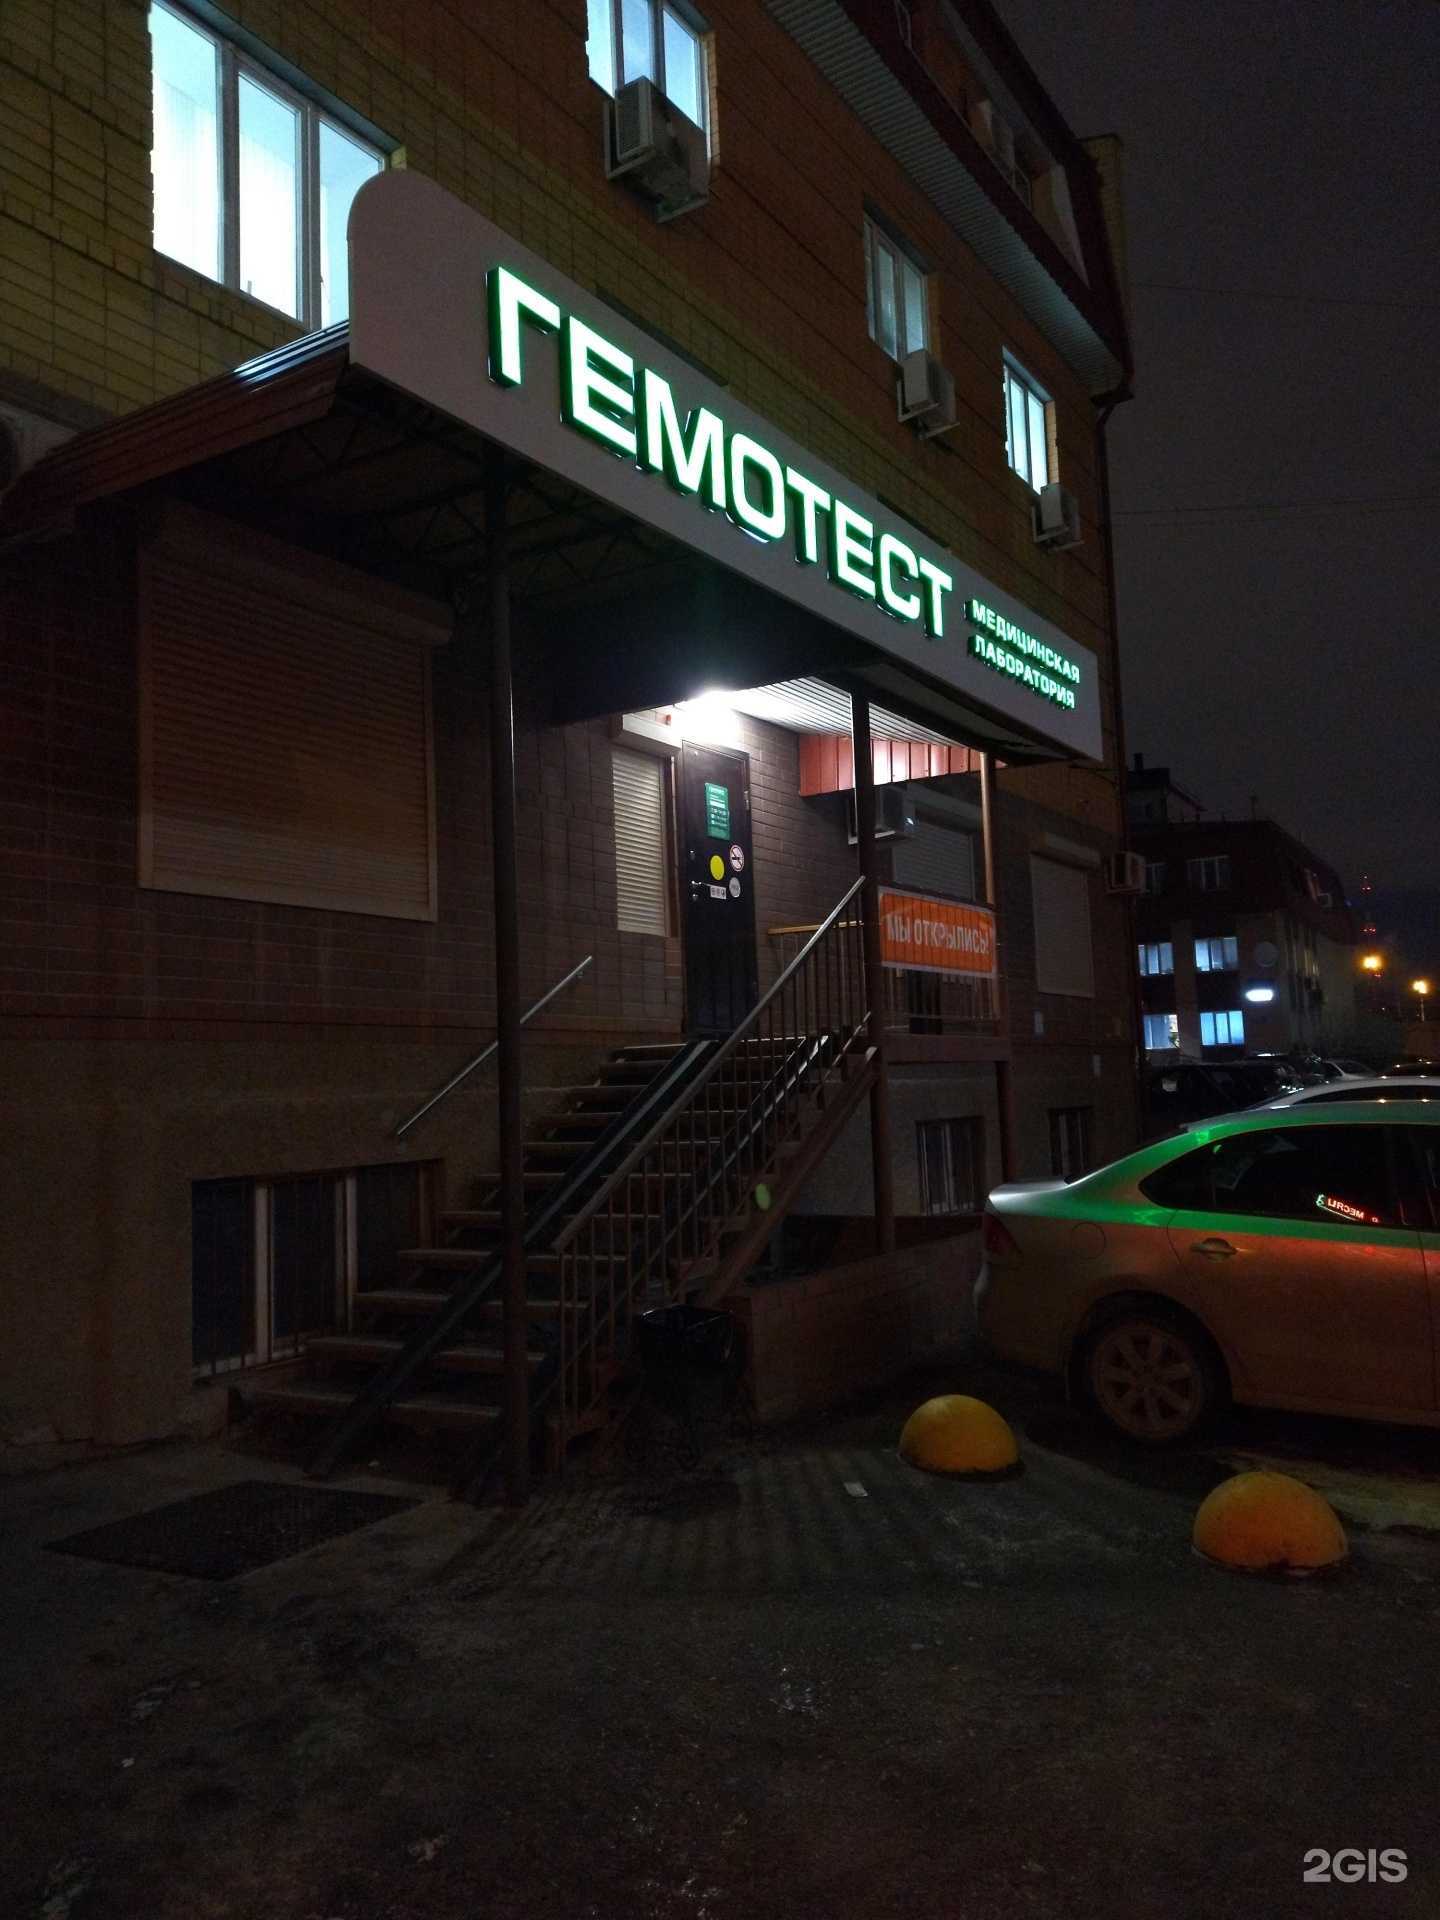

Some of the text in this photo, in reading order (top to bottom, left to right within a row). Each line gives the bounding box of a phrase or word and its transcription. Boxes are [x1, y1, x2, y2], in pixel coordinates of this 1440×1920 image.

[490, 265, 953, 638] ГЕМОТЕСТ
[972, 598, 1081, 684] МЕДИЦИНСКАЯ
[975, 634, 1076, 709] ЛАБОРАТОРИЯ
[886, 912, 911, 943] МЫ
